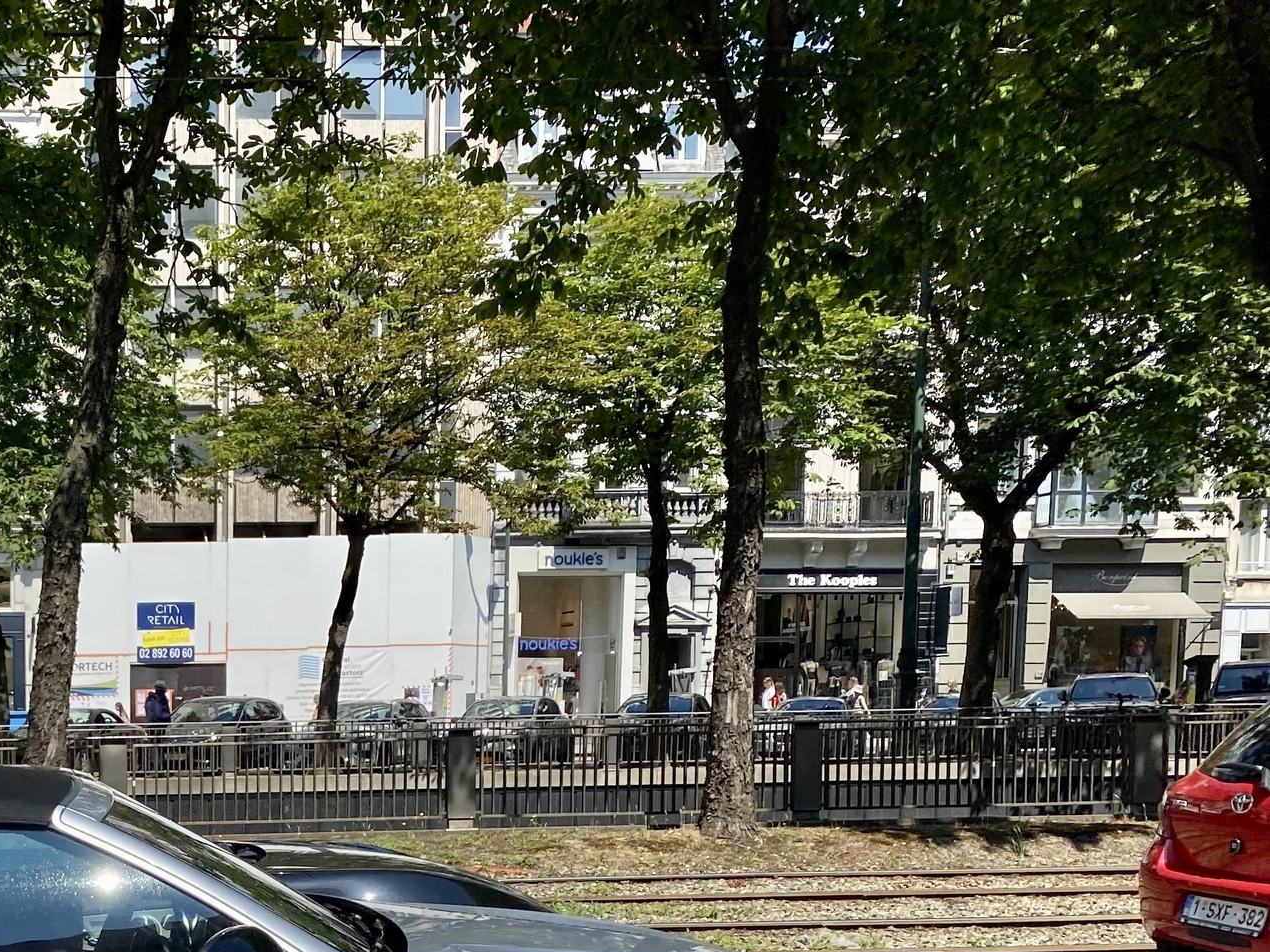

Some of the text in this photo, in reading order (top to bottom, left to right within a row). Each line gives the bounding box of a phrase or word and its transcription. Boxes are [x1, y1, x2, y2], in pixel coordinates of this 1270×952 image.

[545, 551, 604, 566] noukie's
[787, 573, 878, 589] The Kooples
[155, 604, 180, 614] CITY
[147, 615, 185, 625] RETAIL
[519, 638, 578, 651] noukie's
[139, 648, 193, 659] 02 892 60 60
[72, 662, 113, 671] ORTECH
